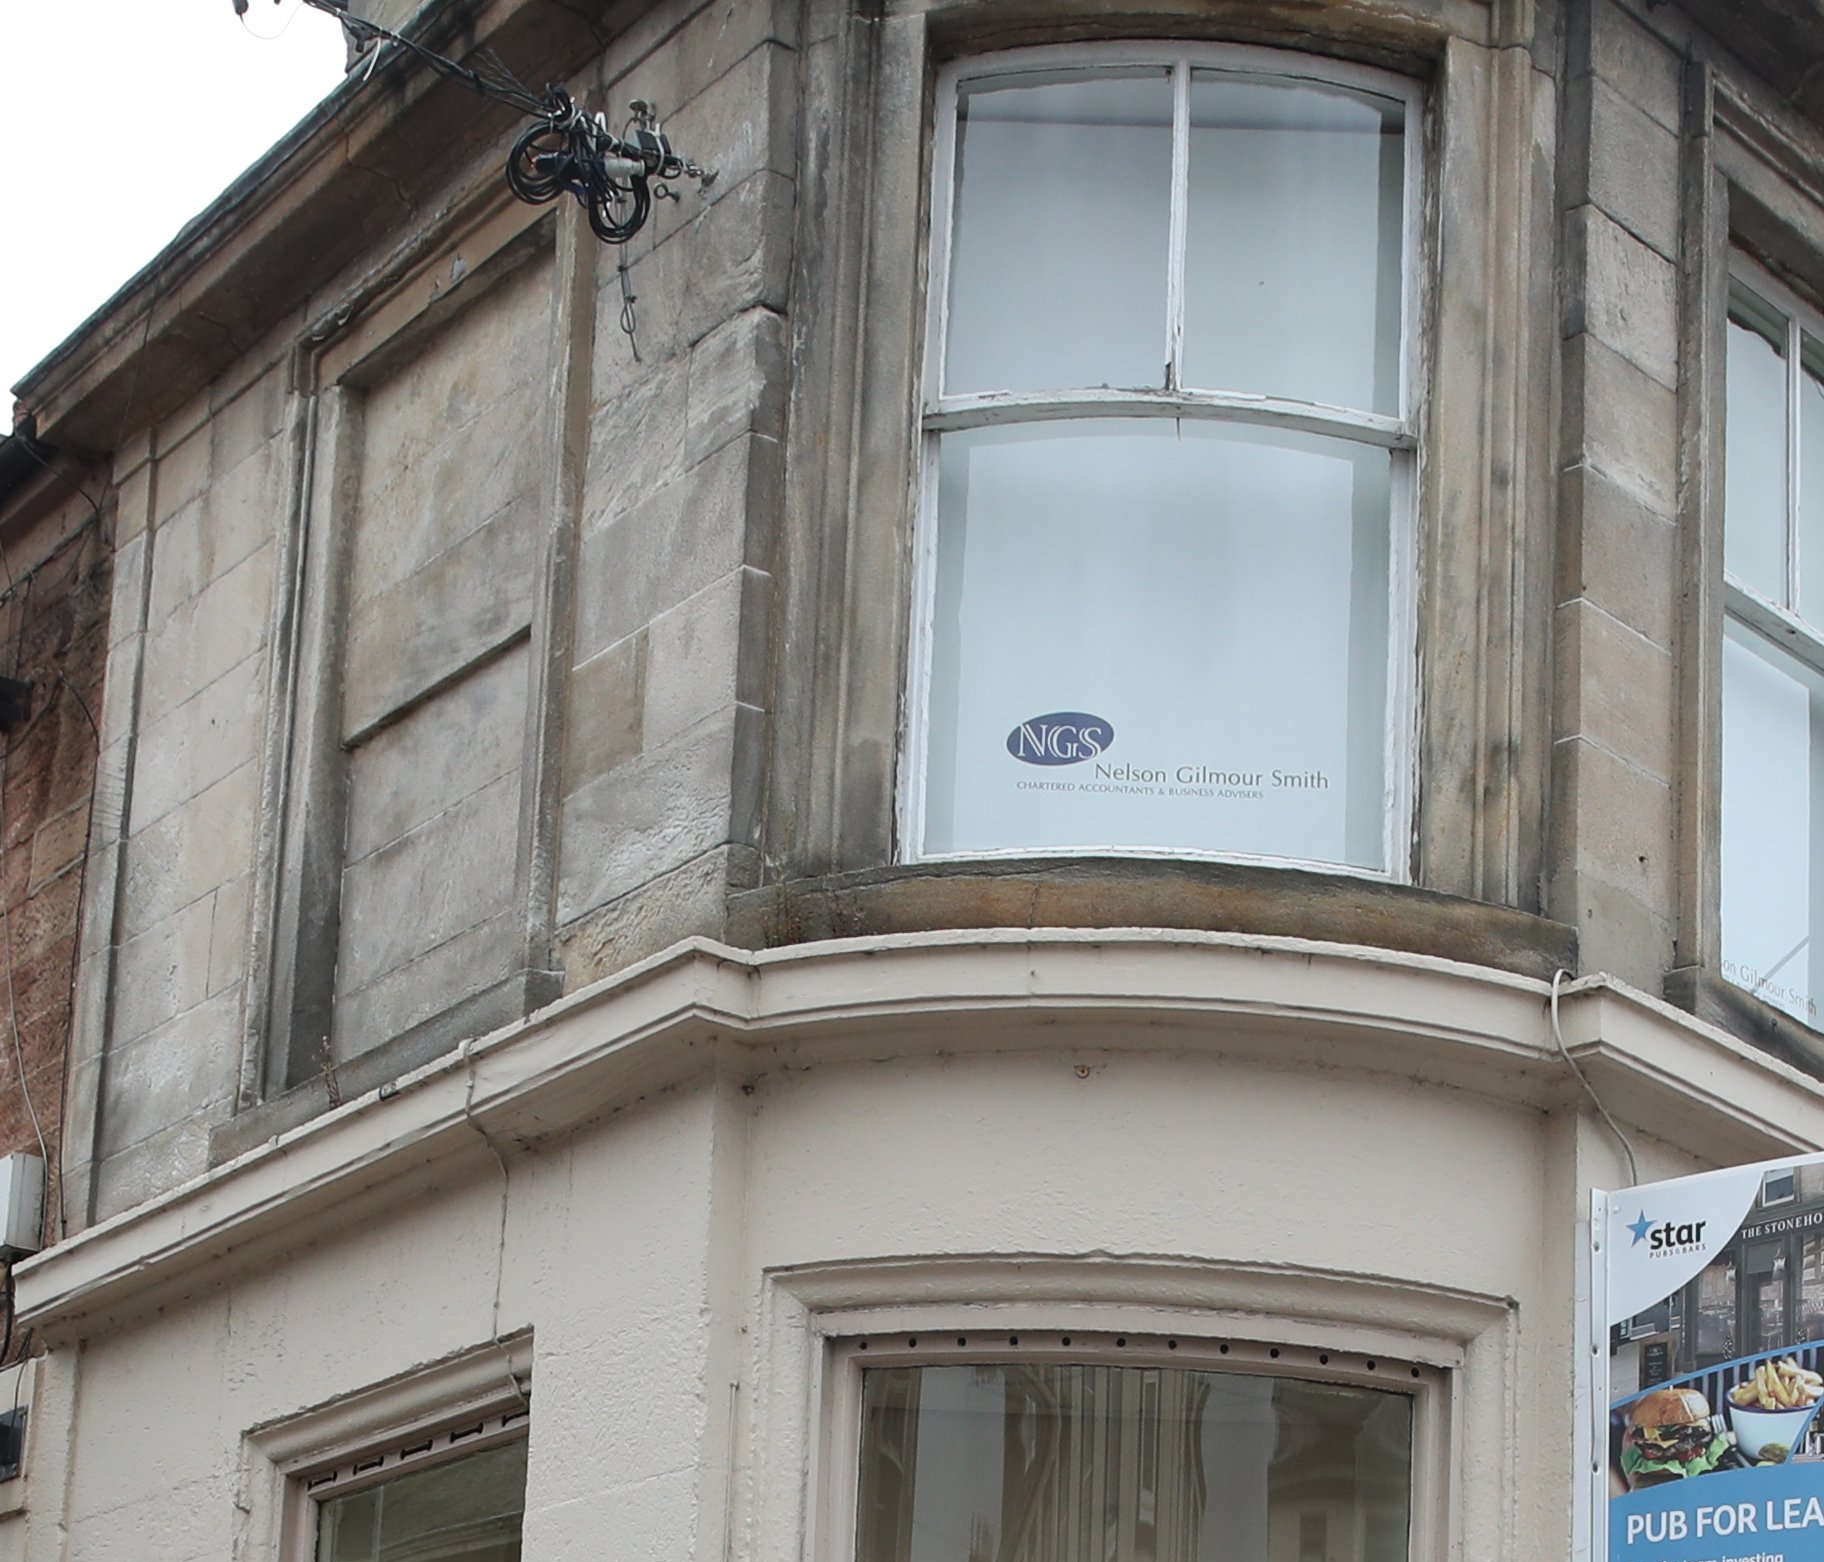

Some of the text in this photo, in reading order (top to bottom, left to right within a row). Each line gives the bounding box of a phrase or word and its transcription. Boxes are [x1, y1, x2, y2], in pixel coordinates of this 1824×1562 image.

[1018, 725, 1102, 759] NGS
[1095, 762, 1328, 789] Nelson Gilmour Smith
[1017, 781, 1075, 791] CHARTERED
[1078, 783, 1154, 795] ACCOUNTANTS
[1169, 788, 1214, 797] BUSINESS
[1217, 789, 1263, 799] ADVISERS
[1650, 1221, 1707, 1250] star
[1741, 1220, 1762, 1239] THE
[1627, 1510, 1688, 1545] PUB
[1696, 1503, 1757, 1538] FOR
